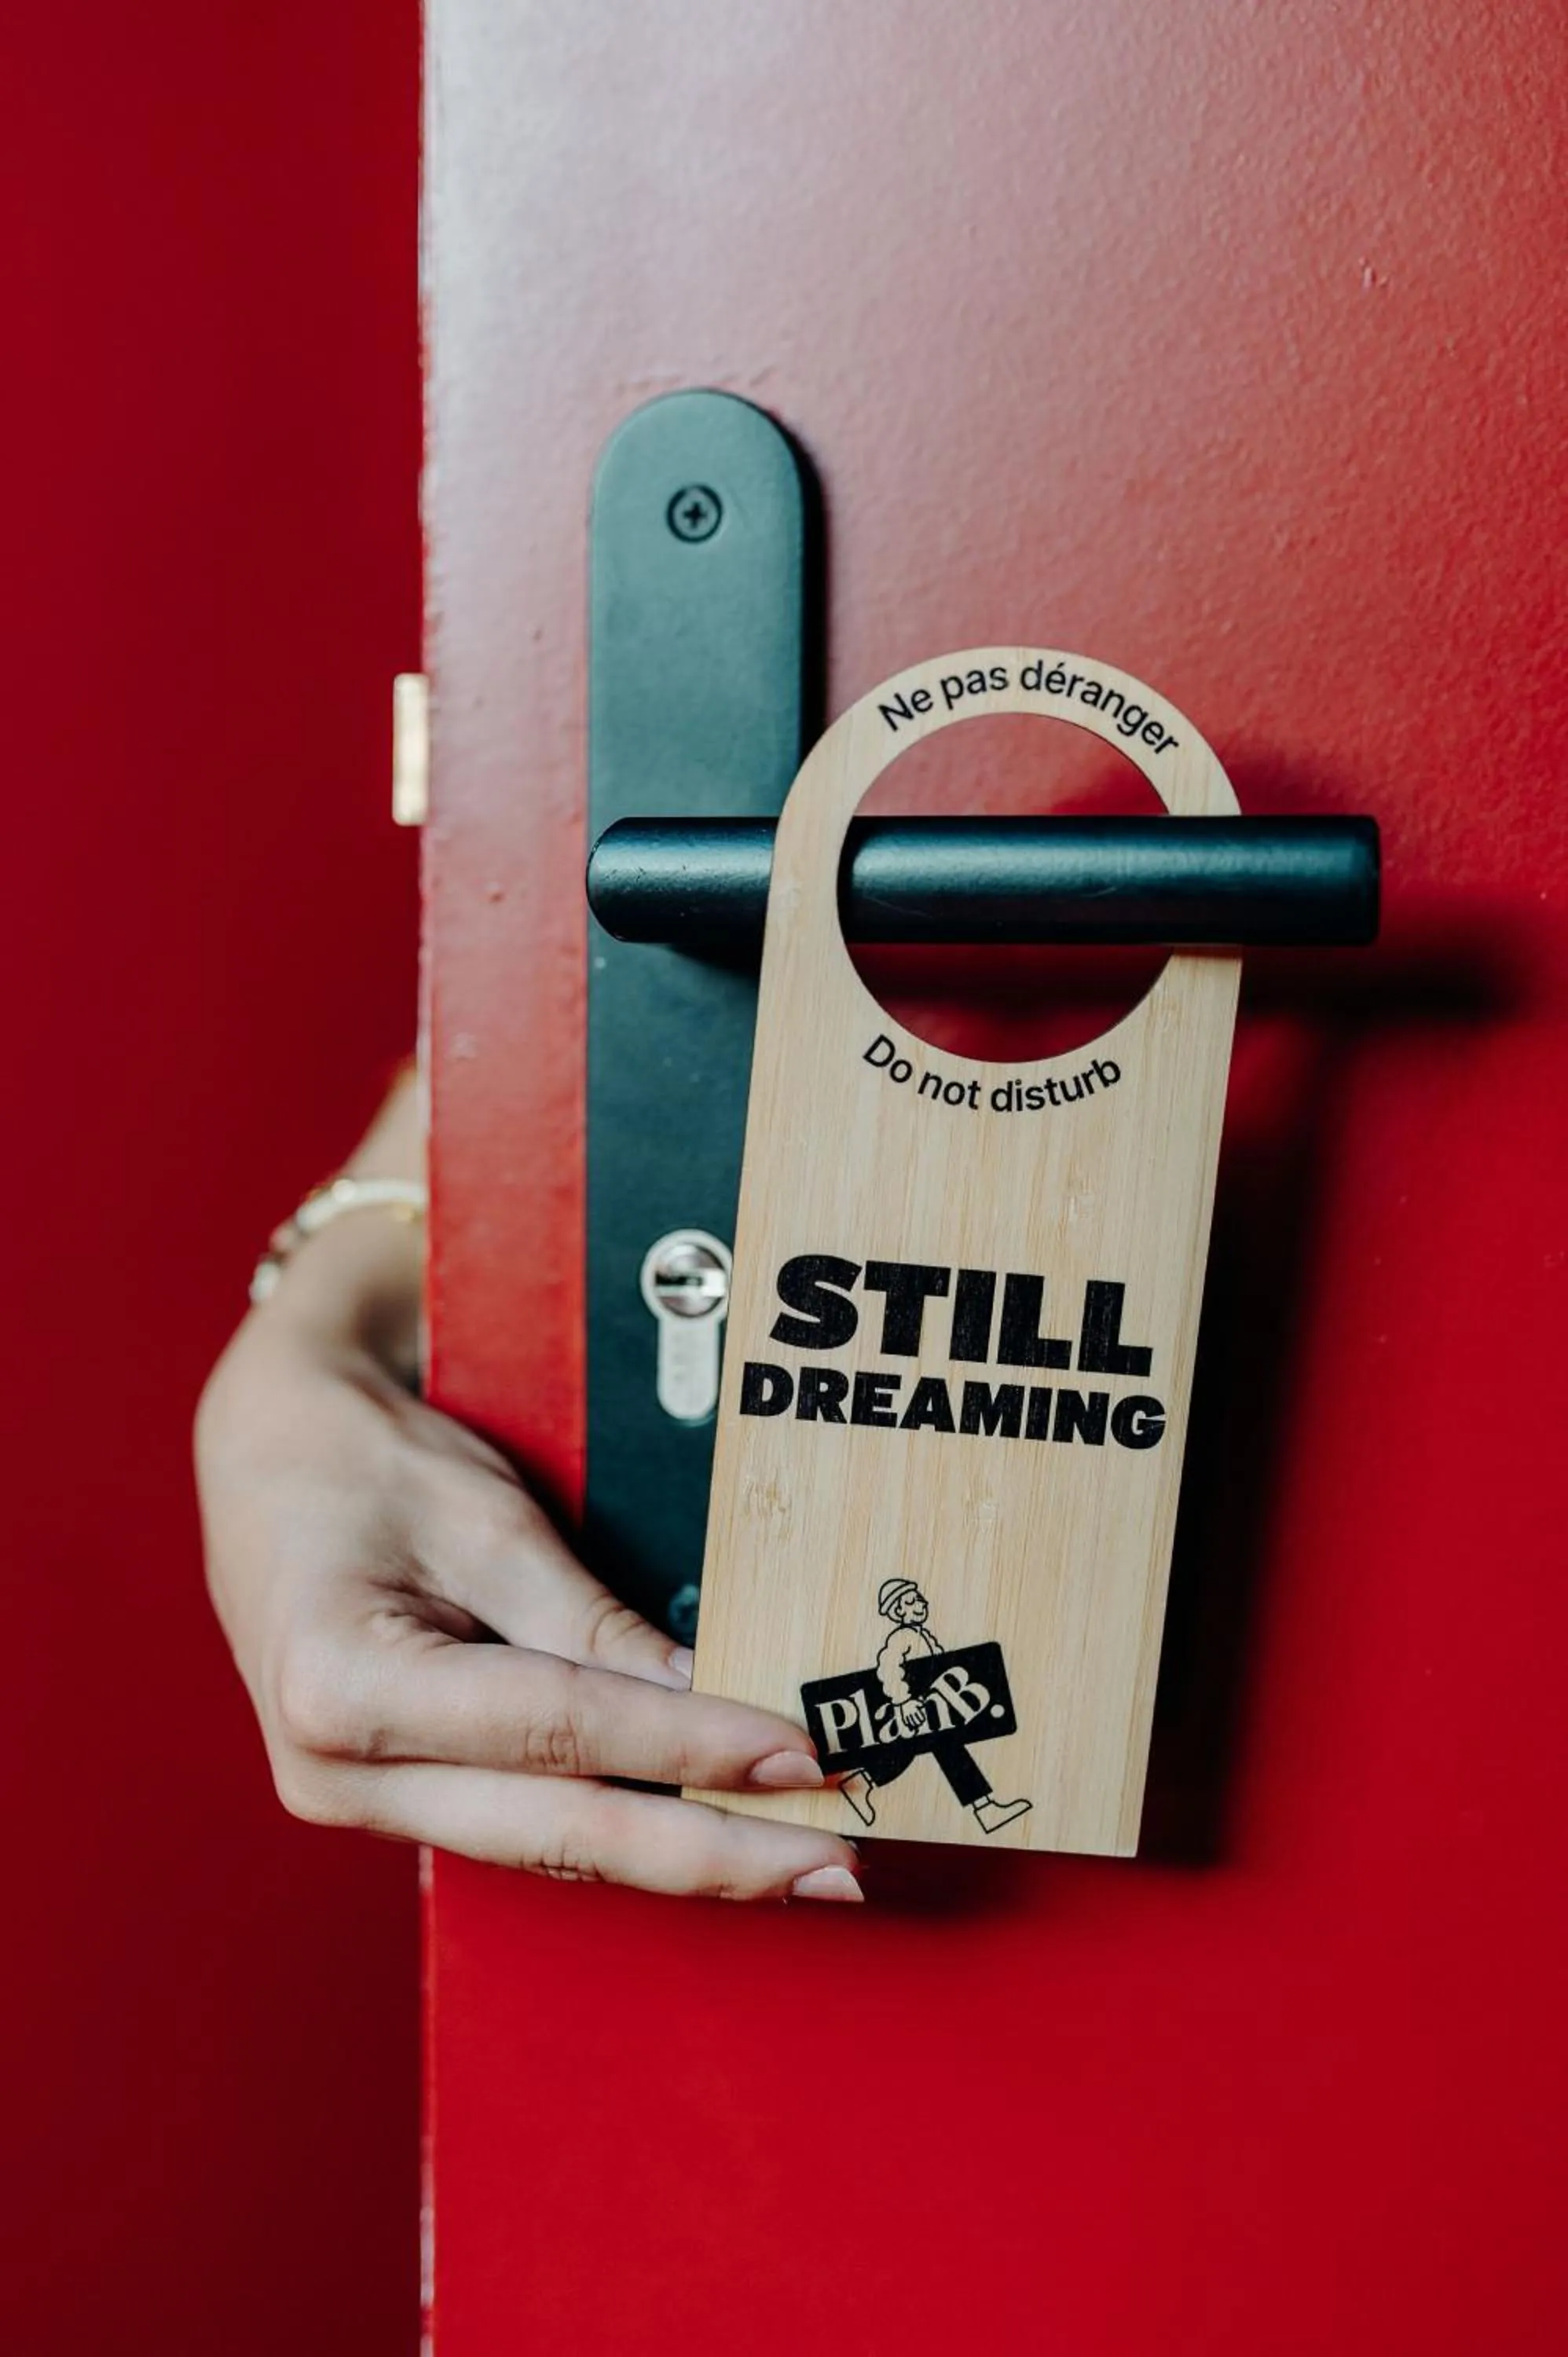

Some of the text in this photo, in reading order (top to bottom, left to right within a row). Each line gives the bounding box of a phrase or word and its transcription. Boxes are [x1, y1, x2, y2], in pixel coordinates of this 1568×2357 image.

[876, 660, 1179, 755] Ne pas déranger
[863, 1035, 1121, 1112] Do not disturb
[769, 1254, 1153, 1376] STILL
[739, 1362, 1166, 1449] DREAMING
